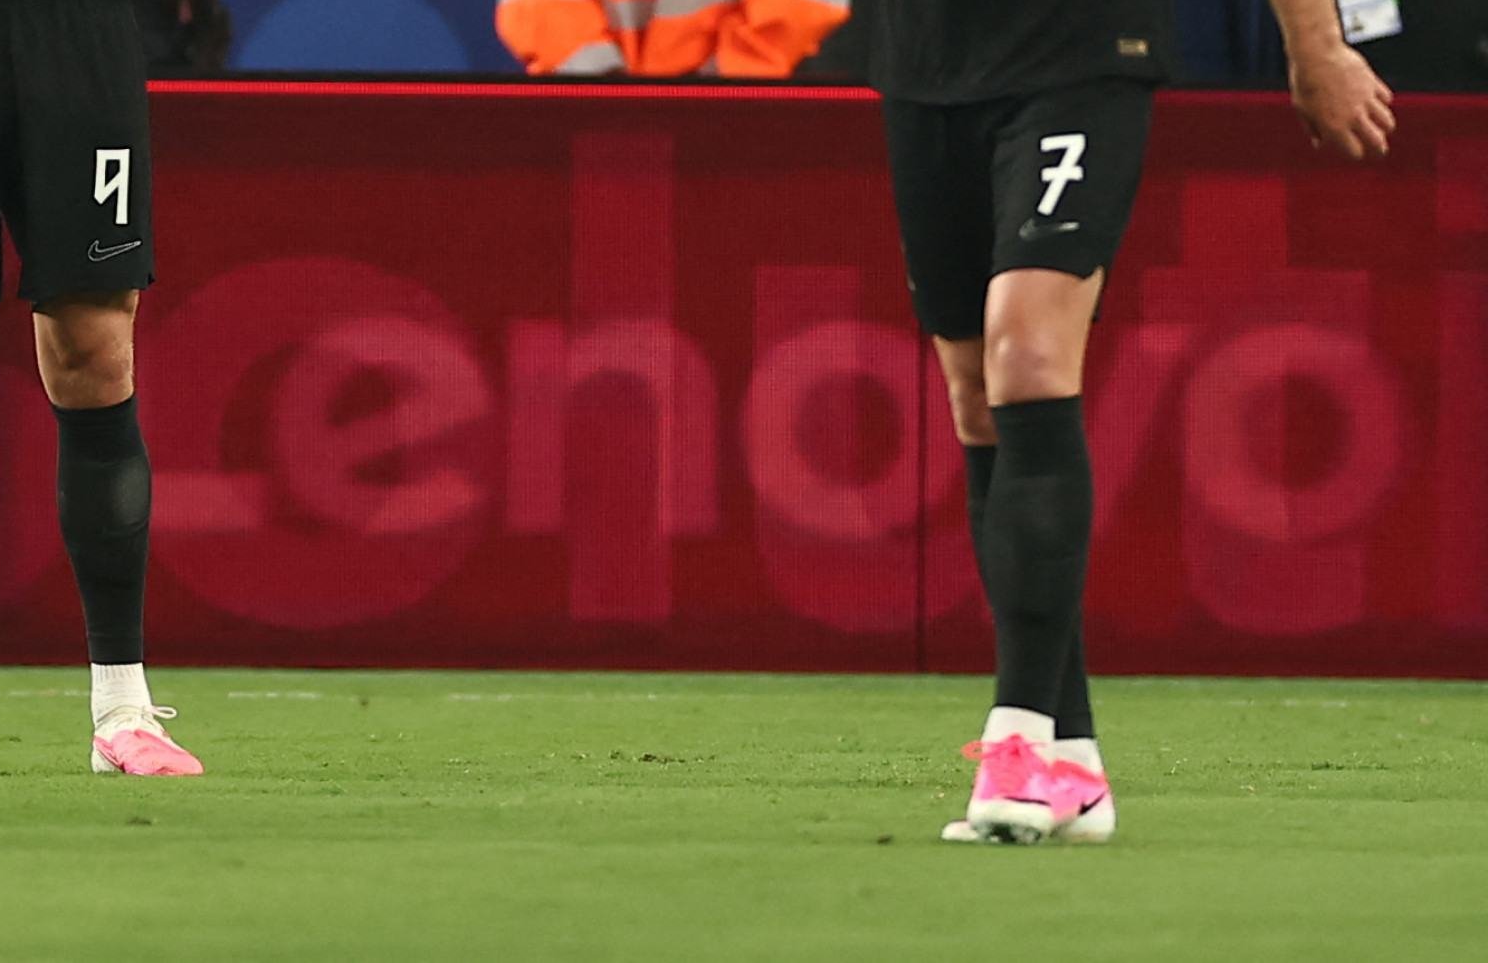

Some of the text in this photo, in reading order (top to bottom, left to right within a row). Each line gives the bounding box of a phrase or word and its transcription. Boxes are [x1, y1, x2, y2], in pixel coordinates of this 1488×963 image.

[94, 148, 130, 225] 9
[1036, 133, 1086, 216] 7
[150, 318, 1404, 536] enovo
